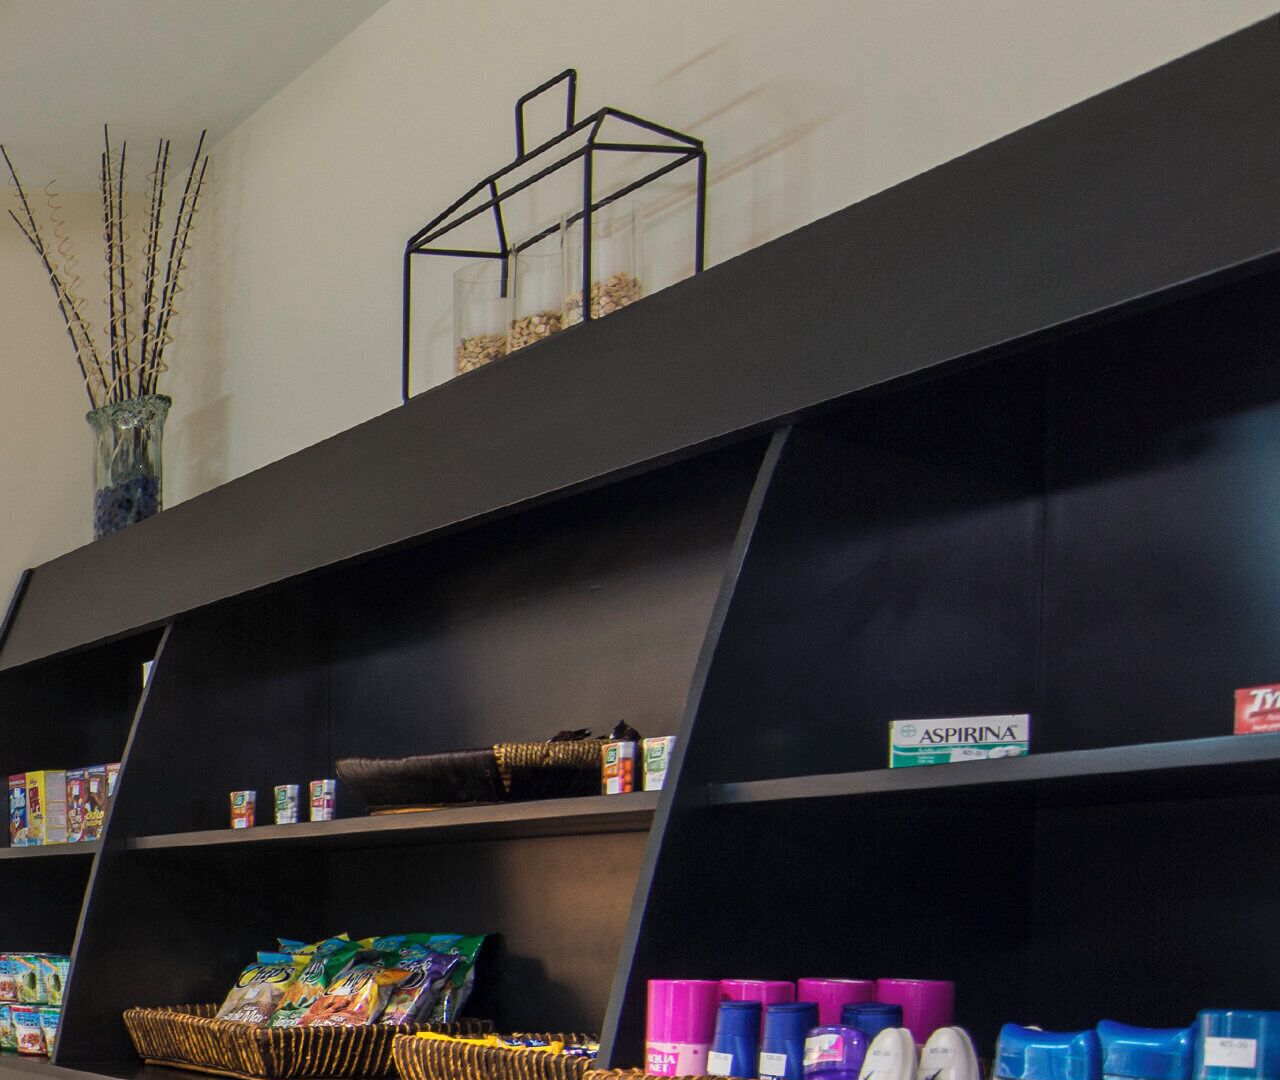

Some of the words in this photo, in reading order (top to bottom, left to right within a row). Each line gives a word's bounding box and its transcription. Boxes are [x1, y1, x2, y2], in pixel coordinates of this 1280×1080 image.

[920, 726, 1017, 744] ASPIRINA
[648, 1053, 676, 1065] AQUA
[649, 1063, 669, 1073] NET
